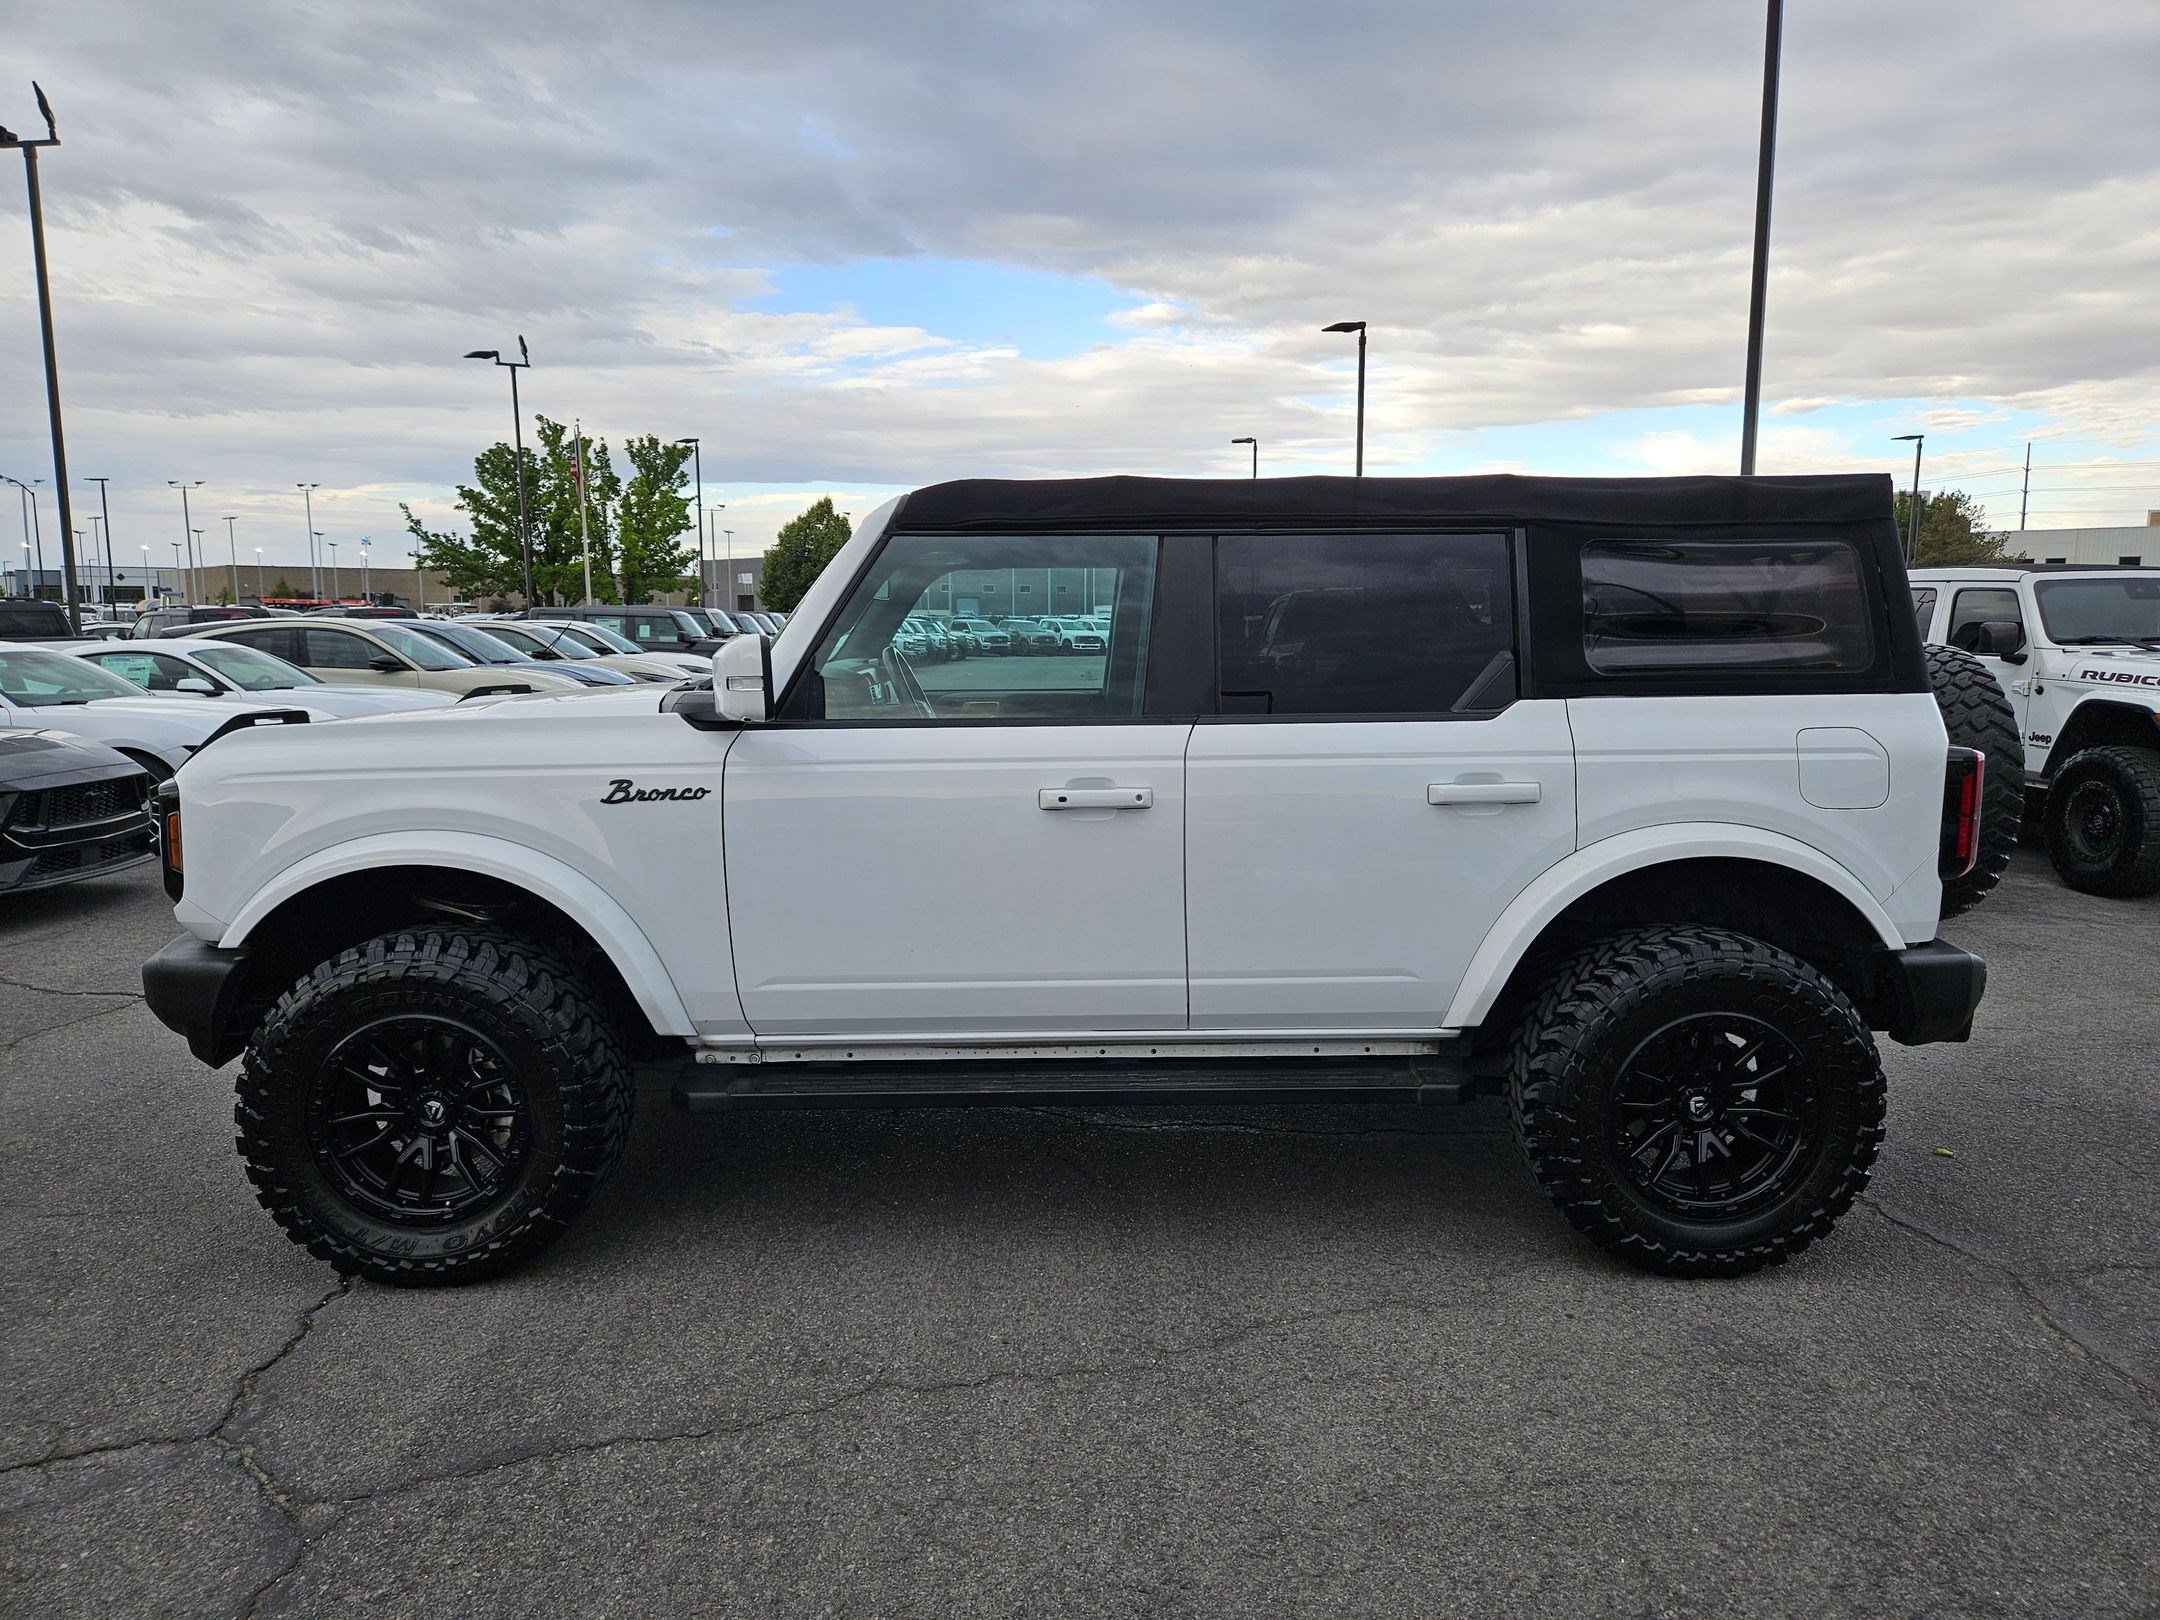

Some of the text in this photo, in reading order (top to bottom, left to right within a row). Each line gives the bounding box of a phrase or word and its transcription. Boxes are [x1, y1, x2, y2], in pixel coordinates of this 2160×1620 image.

[2080, 669, 2160, 686] RUBIC
[2028, 731, 2052, 744] Jeep
[600, 779, 712, 804] Bronco
